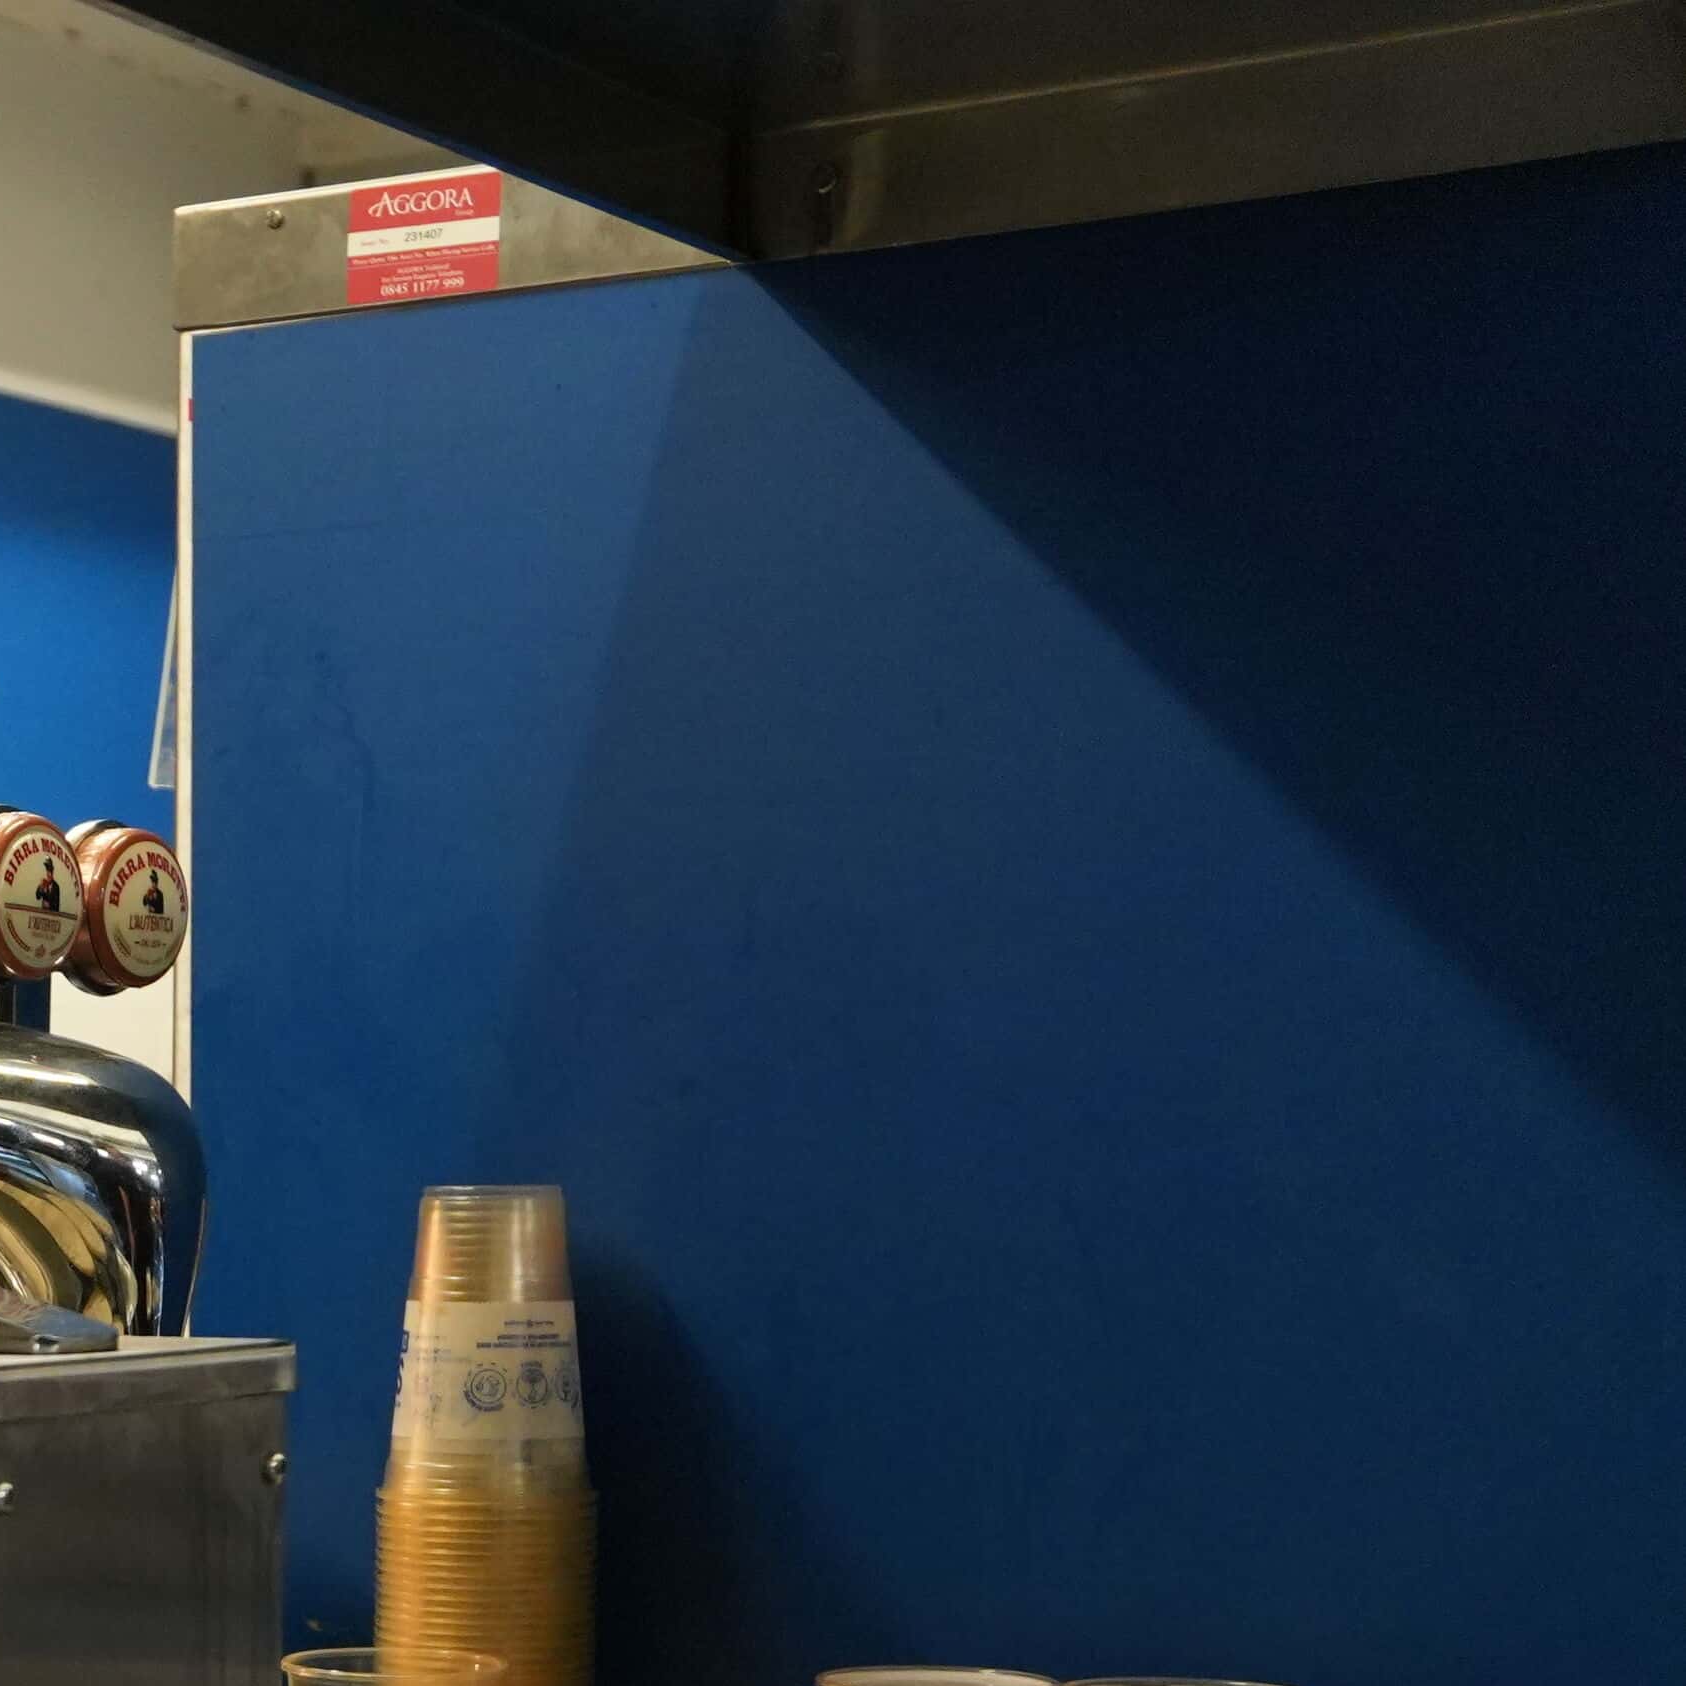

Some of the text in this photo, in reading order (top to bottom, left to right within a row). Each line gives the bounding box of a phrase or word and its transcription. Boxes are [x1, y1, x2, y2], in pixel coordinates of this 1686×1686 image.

[368, 187, 474, 217] AGGORA
[404, 228, 443, 242] 231407
[381, 277, 465, 297] 0845 1177 999
[4, 838, 39, 886] BIRRA
[109, 854, 147, 907] BIRRA
